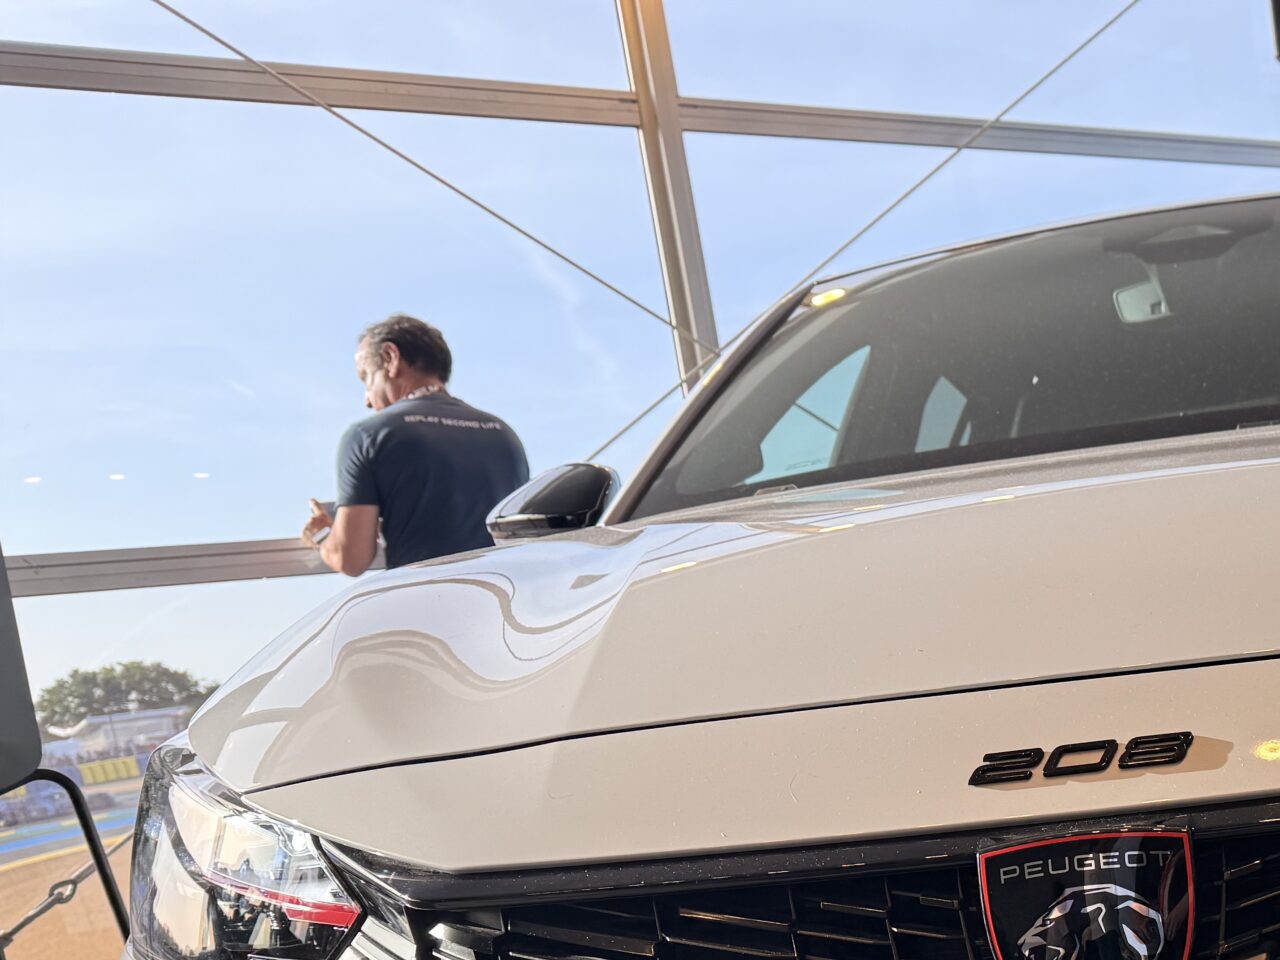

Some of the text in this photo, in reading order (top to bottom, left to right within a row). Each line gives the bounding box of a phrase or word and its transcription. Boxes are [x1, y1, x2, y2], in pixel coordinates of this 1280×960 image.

[404, 415, 501, 430] REPLAY SECOND LIFE
[967, 731, 1195, 786] 208
[999, 850, 1172, 885] PEUGEOT
